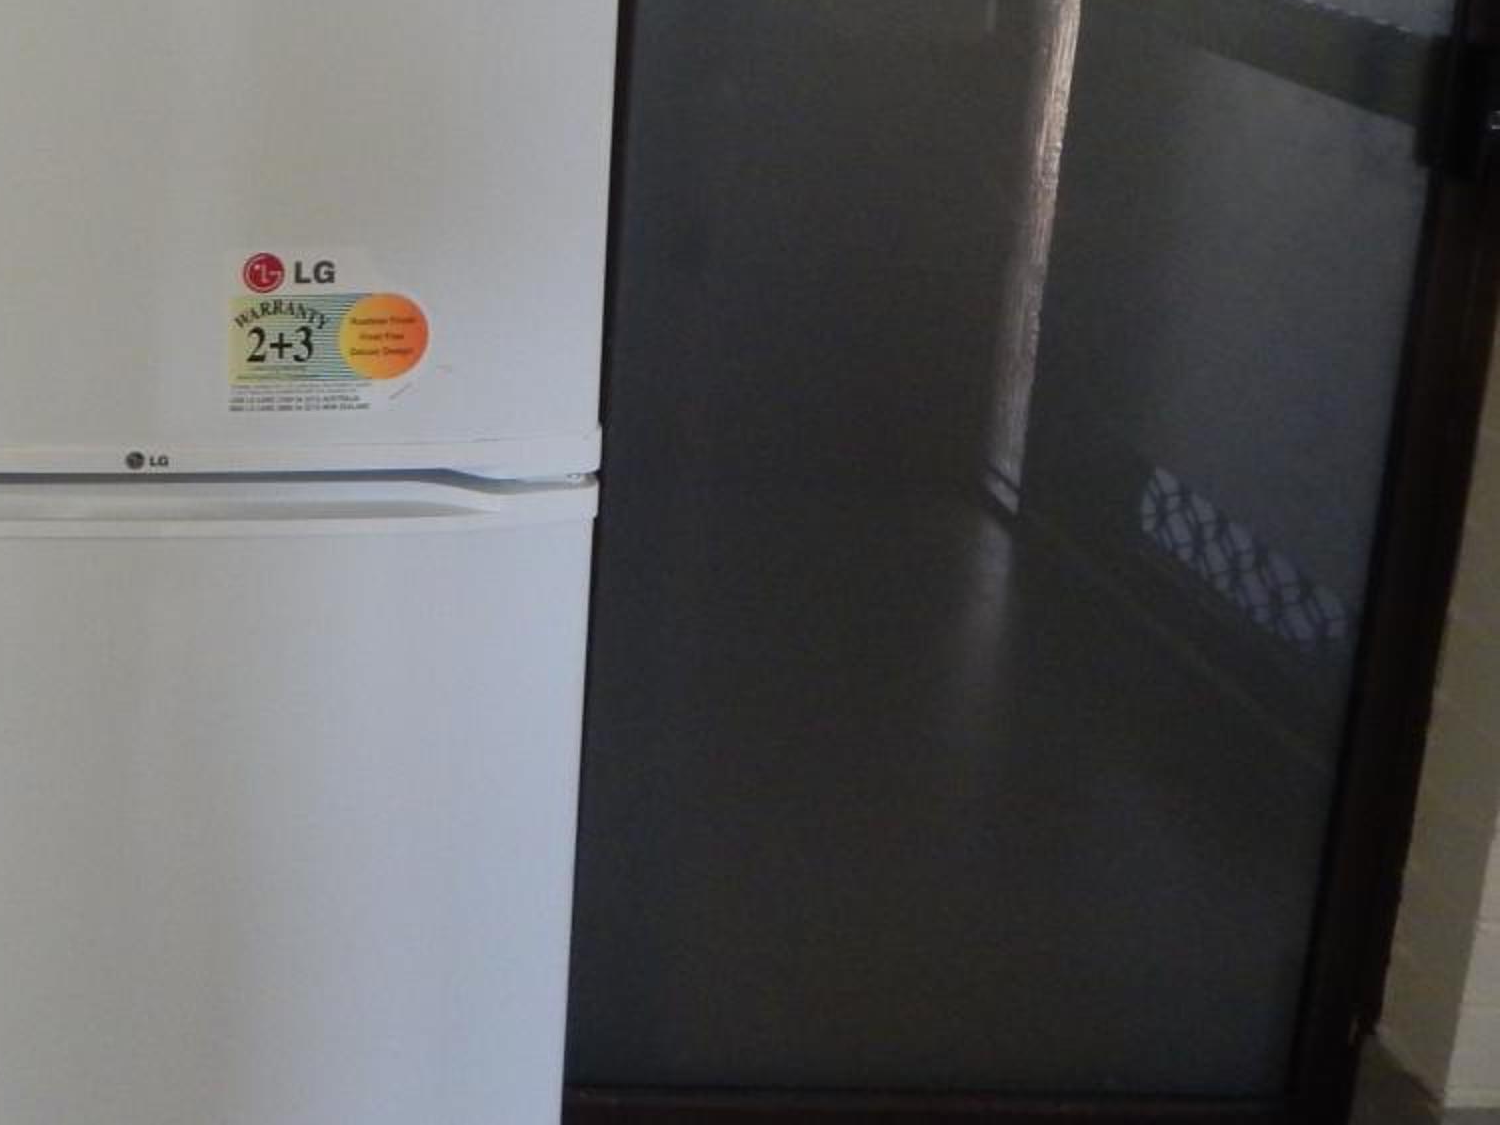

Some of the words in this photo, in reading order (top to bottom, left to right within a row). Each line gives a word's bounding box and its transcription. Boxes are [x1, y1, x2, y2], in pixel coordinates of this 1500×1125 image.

[294, 262, 336, 284] LG
[234, 299, 330, 329] WARRANTY
[246, 326, 314, 363] 2+3
